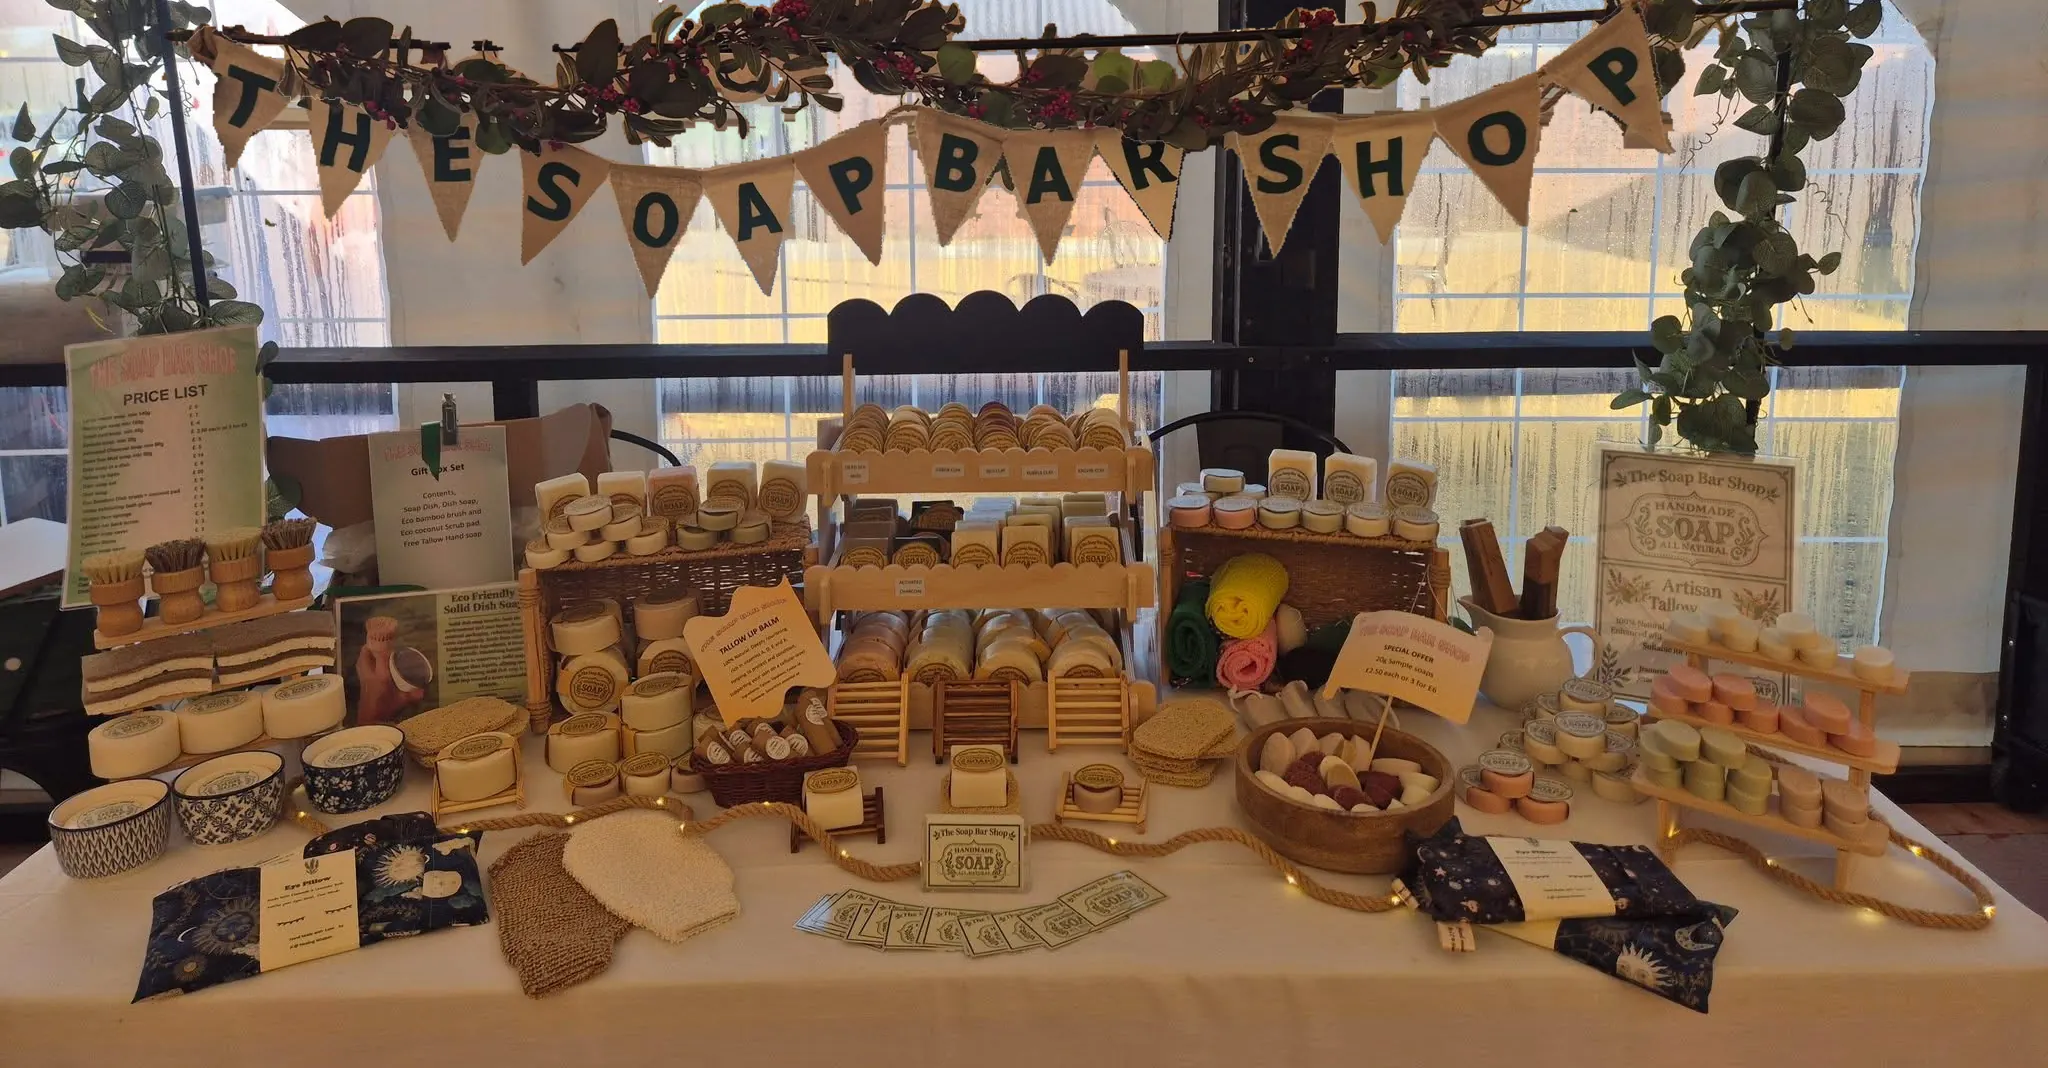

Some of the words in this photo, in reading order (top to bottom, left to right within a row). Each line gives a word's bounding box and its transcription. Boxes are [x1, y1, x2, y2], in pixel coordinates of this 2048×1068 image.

[227, 64, 474, 183] THE
[526, 156, 874, 248] SOAP
[933, 132, 1178, 205] BAR
[1256, 46, 1639, 198] SHOP
[124, 389, 169, 406] PRICE
[174, 384, 208, 399] LIST
[411, 466, 428, 476] Gift
[450, 463, 465, 472] Set
[1280, 484, 1300, 492] SOAP
[1628, 469, 1656, 484] The
[1658, 469, 1694, 486] Soap
[1698, 472, 1725, 487] Bar
[1727, 476, 1766, 498] Shop
[422, 489, 457, 500] Contents,
[1397, 488, 1419, 500] SOAP
[403, 506, 422, 514] Soap
[423, 502, 441, 512] Dish,
[442, 500, 458, 508] Dish
[459, 498, 479, 506] Soap,
[1654, 502, 1736, 518] HANDMADE
[402, 517, 414, 525] Eco
[416, 513, 445, 522] bamboo
[446, 510, 467, 518] brush
[415, 526, 444, 534] coconut
[444, 522, 465, 530] Scrub
[1655, 515, 1735, 545] SOAP
[421, 536, 444, 544] Tallow
[446, 533, 464, 542] Hand
[464, 531, 482, 539] soap
[1659, 540, 1681, 550] ALL
[1682, 542, 1728, 556] NATURAL
[452, 594, 470, 602] Eco
[472, 588, 516, 600] Friendly
[1662, 578, 1722, 600] Artisan
[444, 602, 470, 614] Solid
[473, 601, 496, 611] Dish
[500, 599, 520, 610] Soa
[1650, 594, 1698, 613] Tallow
[720, 634, 746, 655] TALLOW
[747, 628, 758, 640] LIP
[758, 616, 780, 632] BALM
[1384, 644, 1410, 656] SPECIAL
[1411, 651, 1434, 664] OFFER
[1376, 656, 1388, 664] 20g
[1388, 657, 1412, 671] Sample
[1414, 666, 1434, 678] soaps
[1365, 667, 1383, 676] £2.50
[1384, 670, 1400, 680] each
[1416, 680, 1427, 689] for
[1428, 684, 1438, 694] £6
[582, 684, 603, 694] SOAP
[940, 829, 955, 837] The
[956, 828, 974, 837] Soap
[975, 828, 988, 836] Bar
[989, 828, 1008, 839] Shop
[955, 856, 995, 870] SOAP
[302, 876, 332, 886] Pillow
[1100, 890, 1132, 908] SOAP
[1059, 915, 1084, 930] SOA
